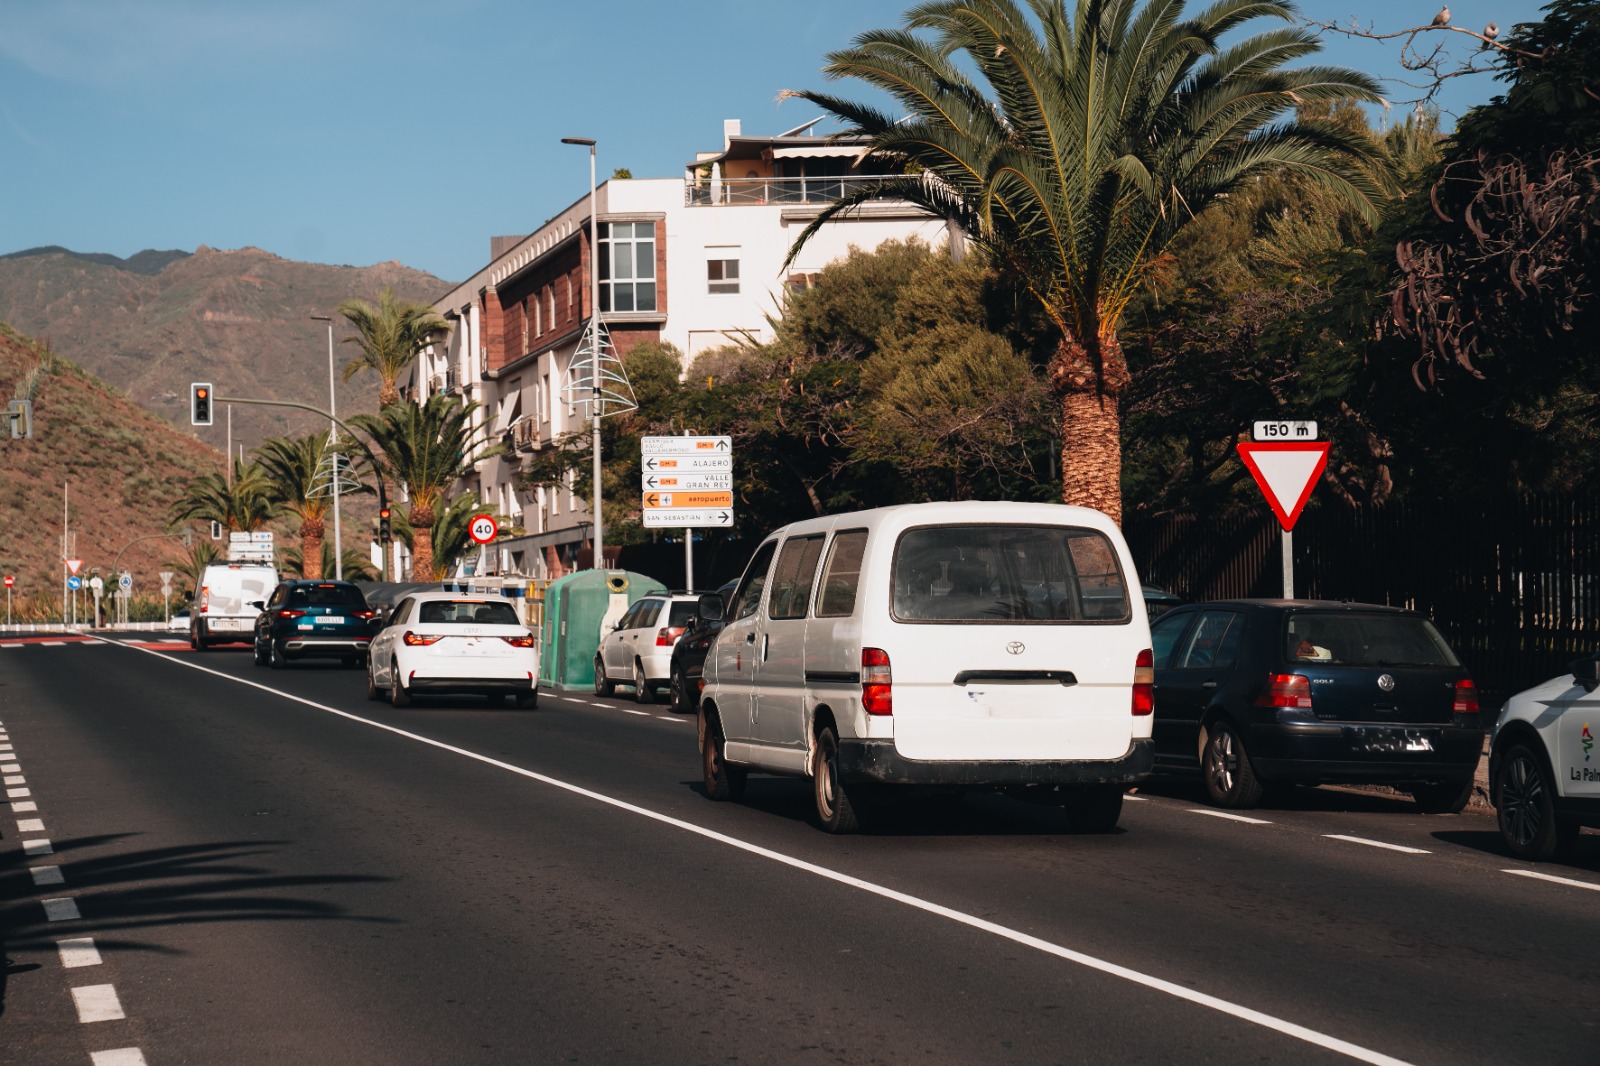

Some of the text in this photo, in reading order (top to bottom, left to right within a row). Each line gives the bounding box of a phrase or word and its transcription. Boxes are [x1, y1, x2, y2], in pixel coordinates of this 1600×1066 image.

[1263, 424, 1309, 436] 150 m
[475, 525, 492, 534] 40
[1571, 766, 1581, 780] La
